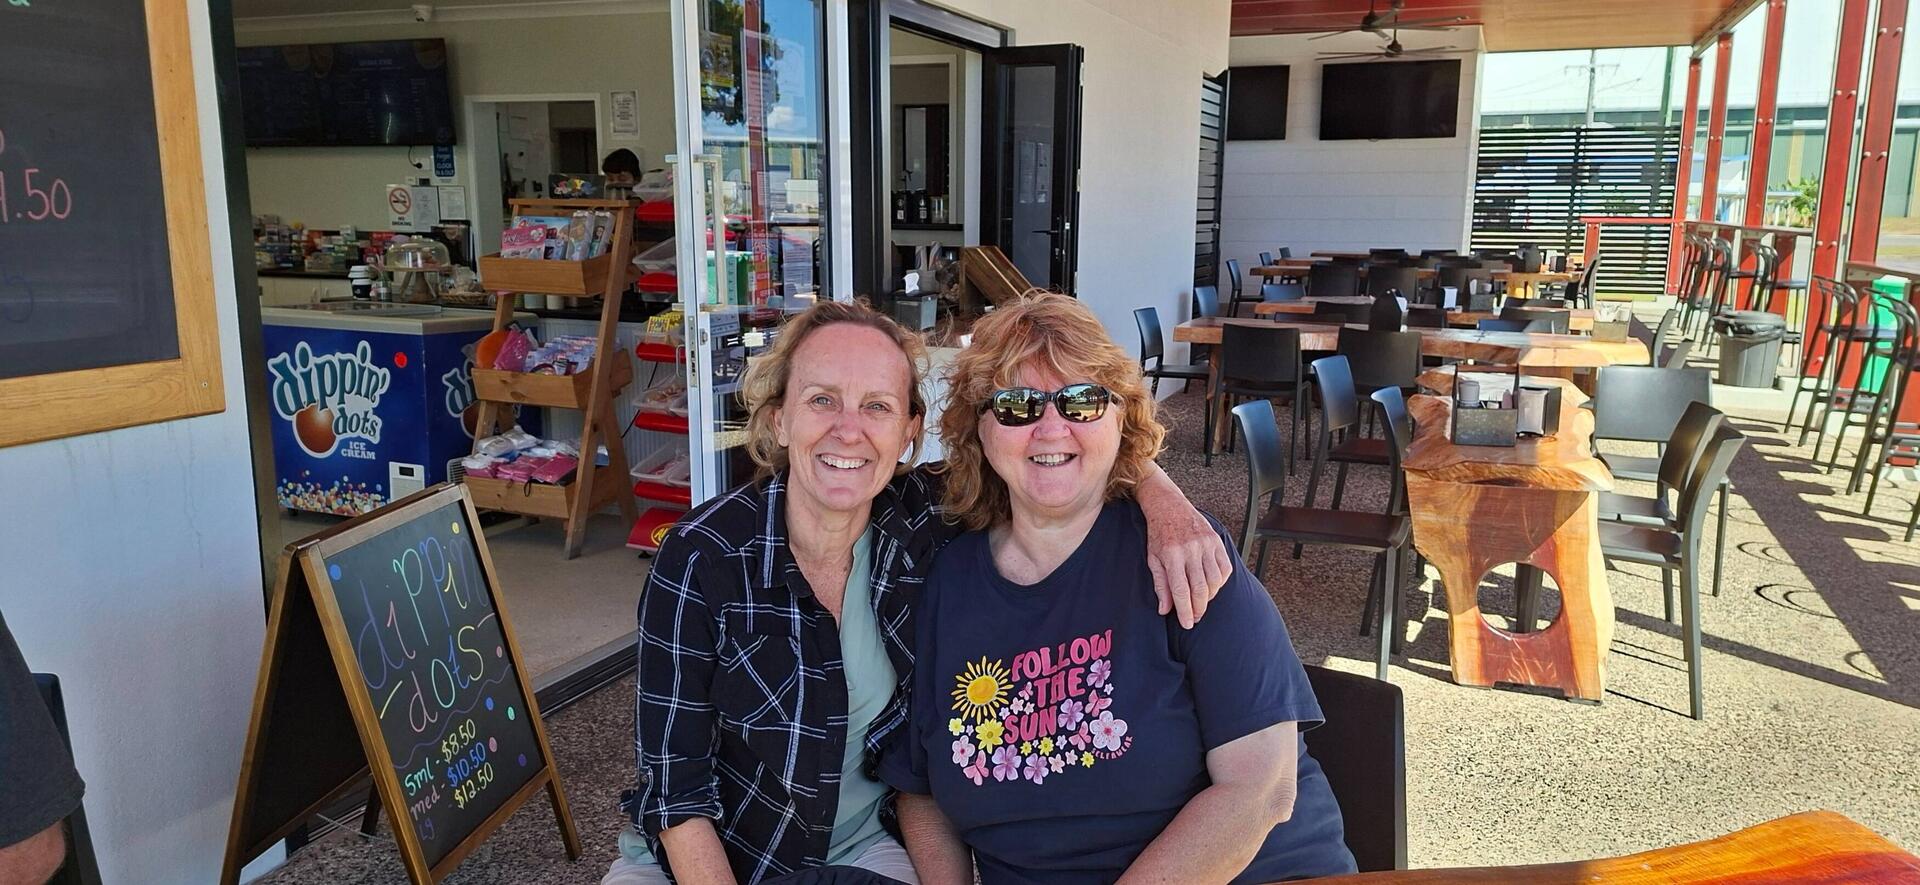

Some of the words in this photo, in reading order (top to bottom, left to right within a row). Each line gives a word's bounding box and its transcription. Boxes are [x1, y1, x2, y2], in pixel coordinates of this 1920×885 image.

[334, 407, 379, 438] dots
[341, 449, 376, 460] CREAM
[349, 441, 367, 451] ICE
[359, 537, 489, 690] dippin
[410, 625, 484, 732] dots
[1011, 629, 1112, 682] FOLLOW
[1033, 667, 1085, 708] THE
[441, 718, 476, 764] $8.50
[1004, 705, 1057, 744] SUN
[410, 784, 440, 821] med
[447, 742, 486, 788] $10.50
[454, 762, 494, 810] $12.50
